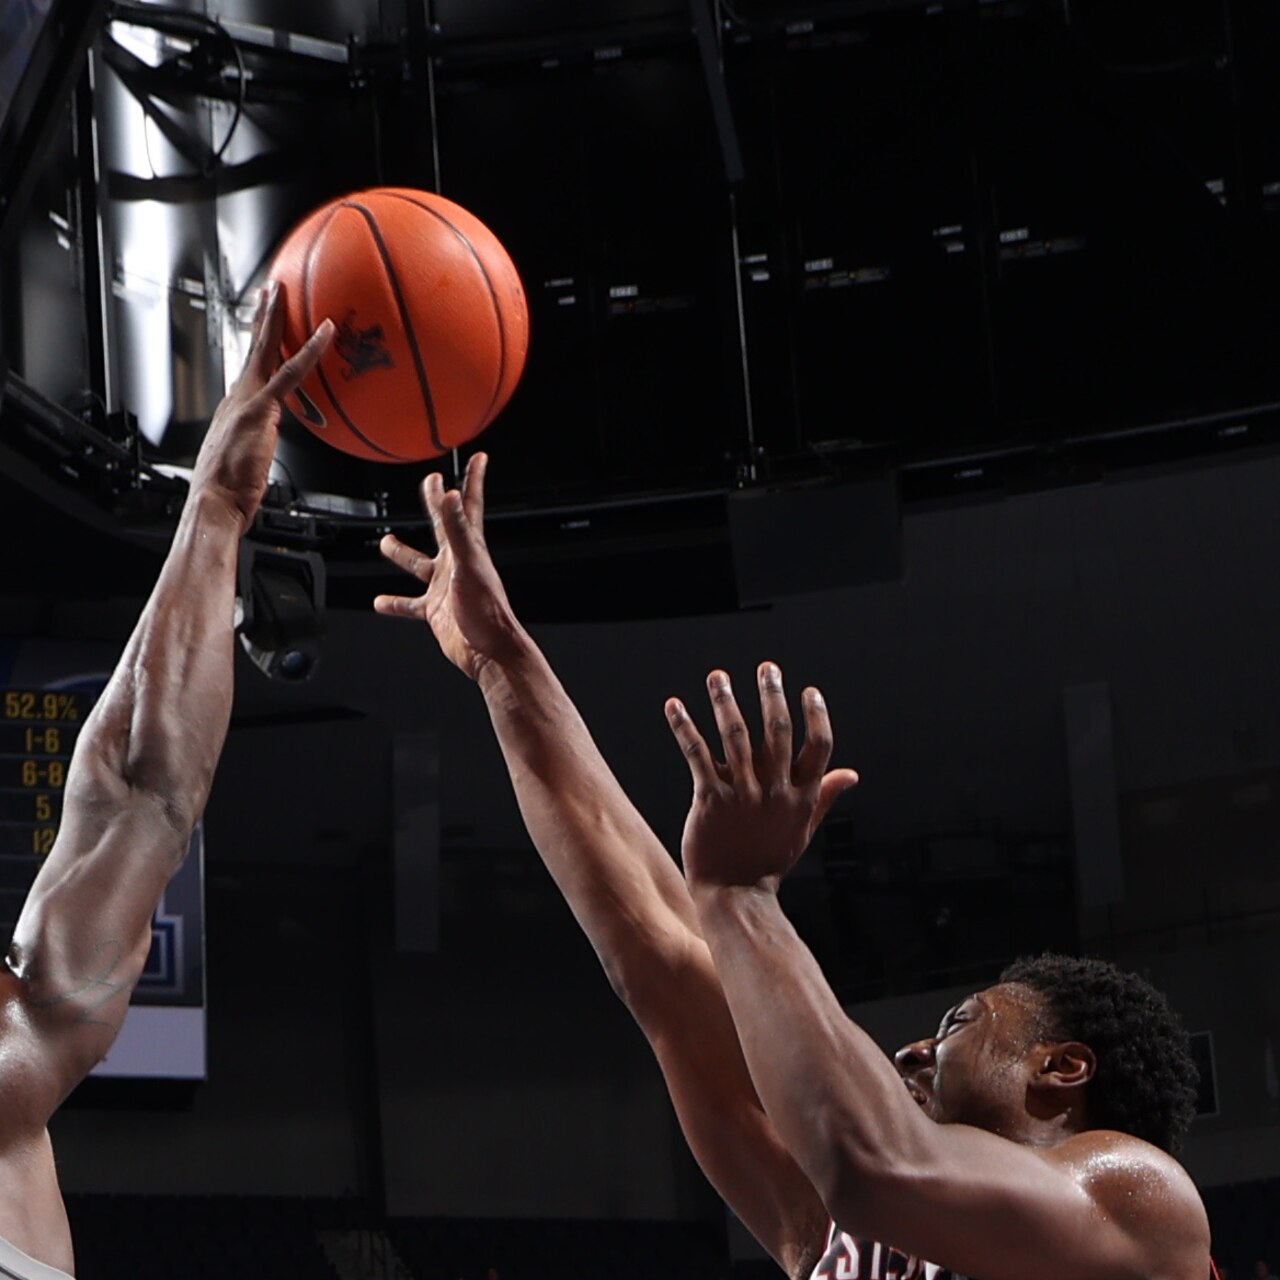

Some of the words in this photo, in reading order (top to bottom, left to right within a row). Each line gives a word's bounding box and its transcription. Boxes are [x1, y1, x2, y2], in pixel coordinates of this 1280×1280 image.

[5, 692, 78, 721] 52.9%
[25, 727, 60, 753] 1-6
[22, 759, 64, 788] 6-8
[35, 794, 52, 821] 5
